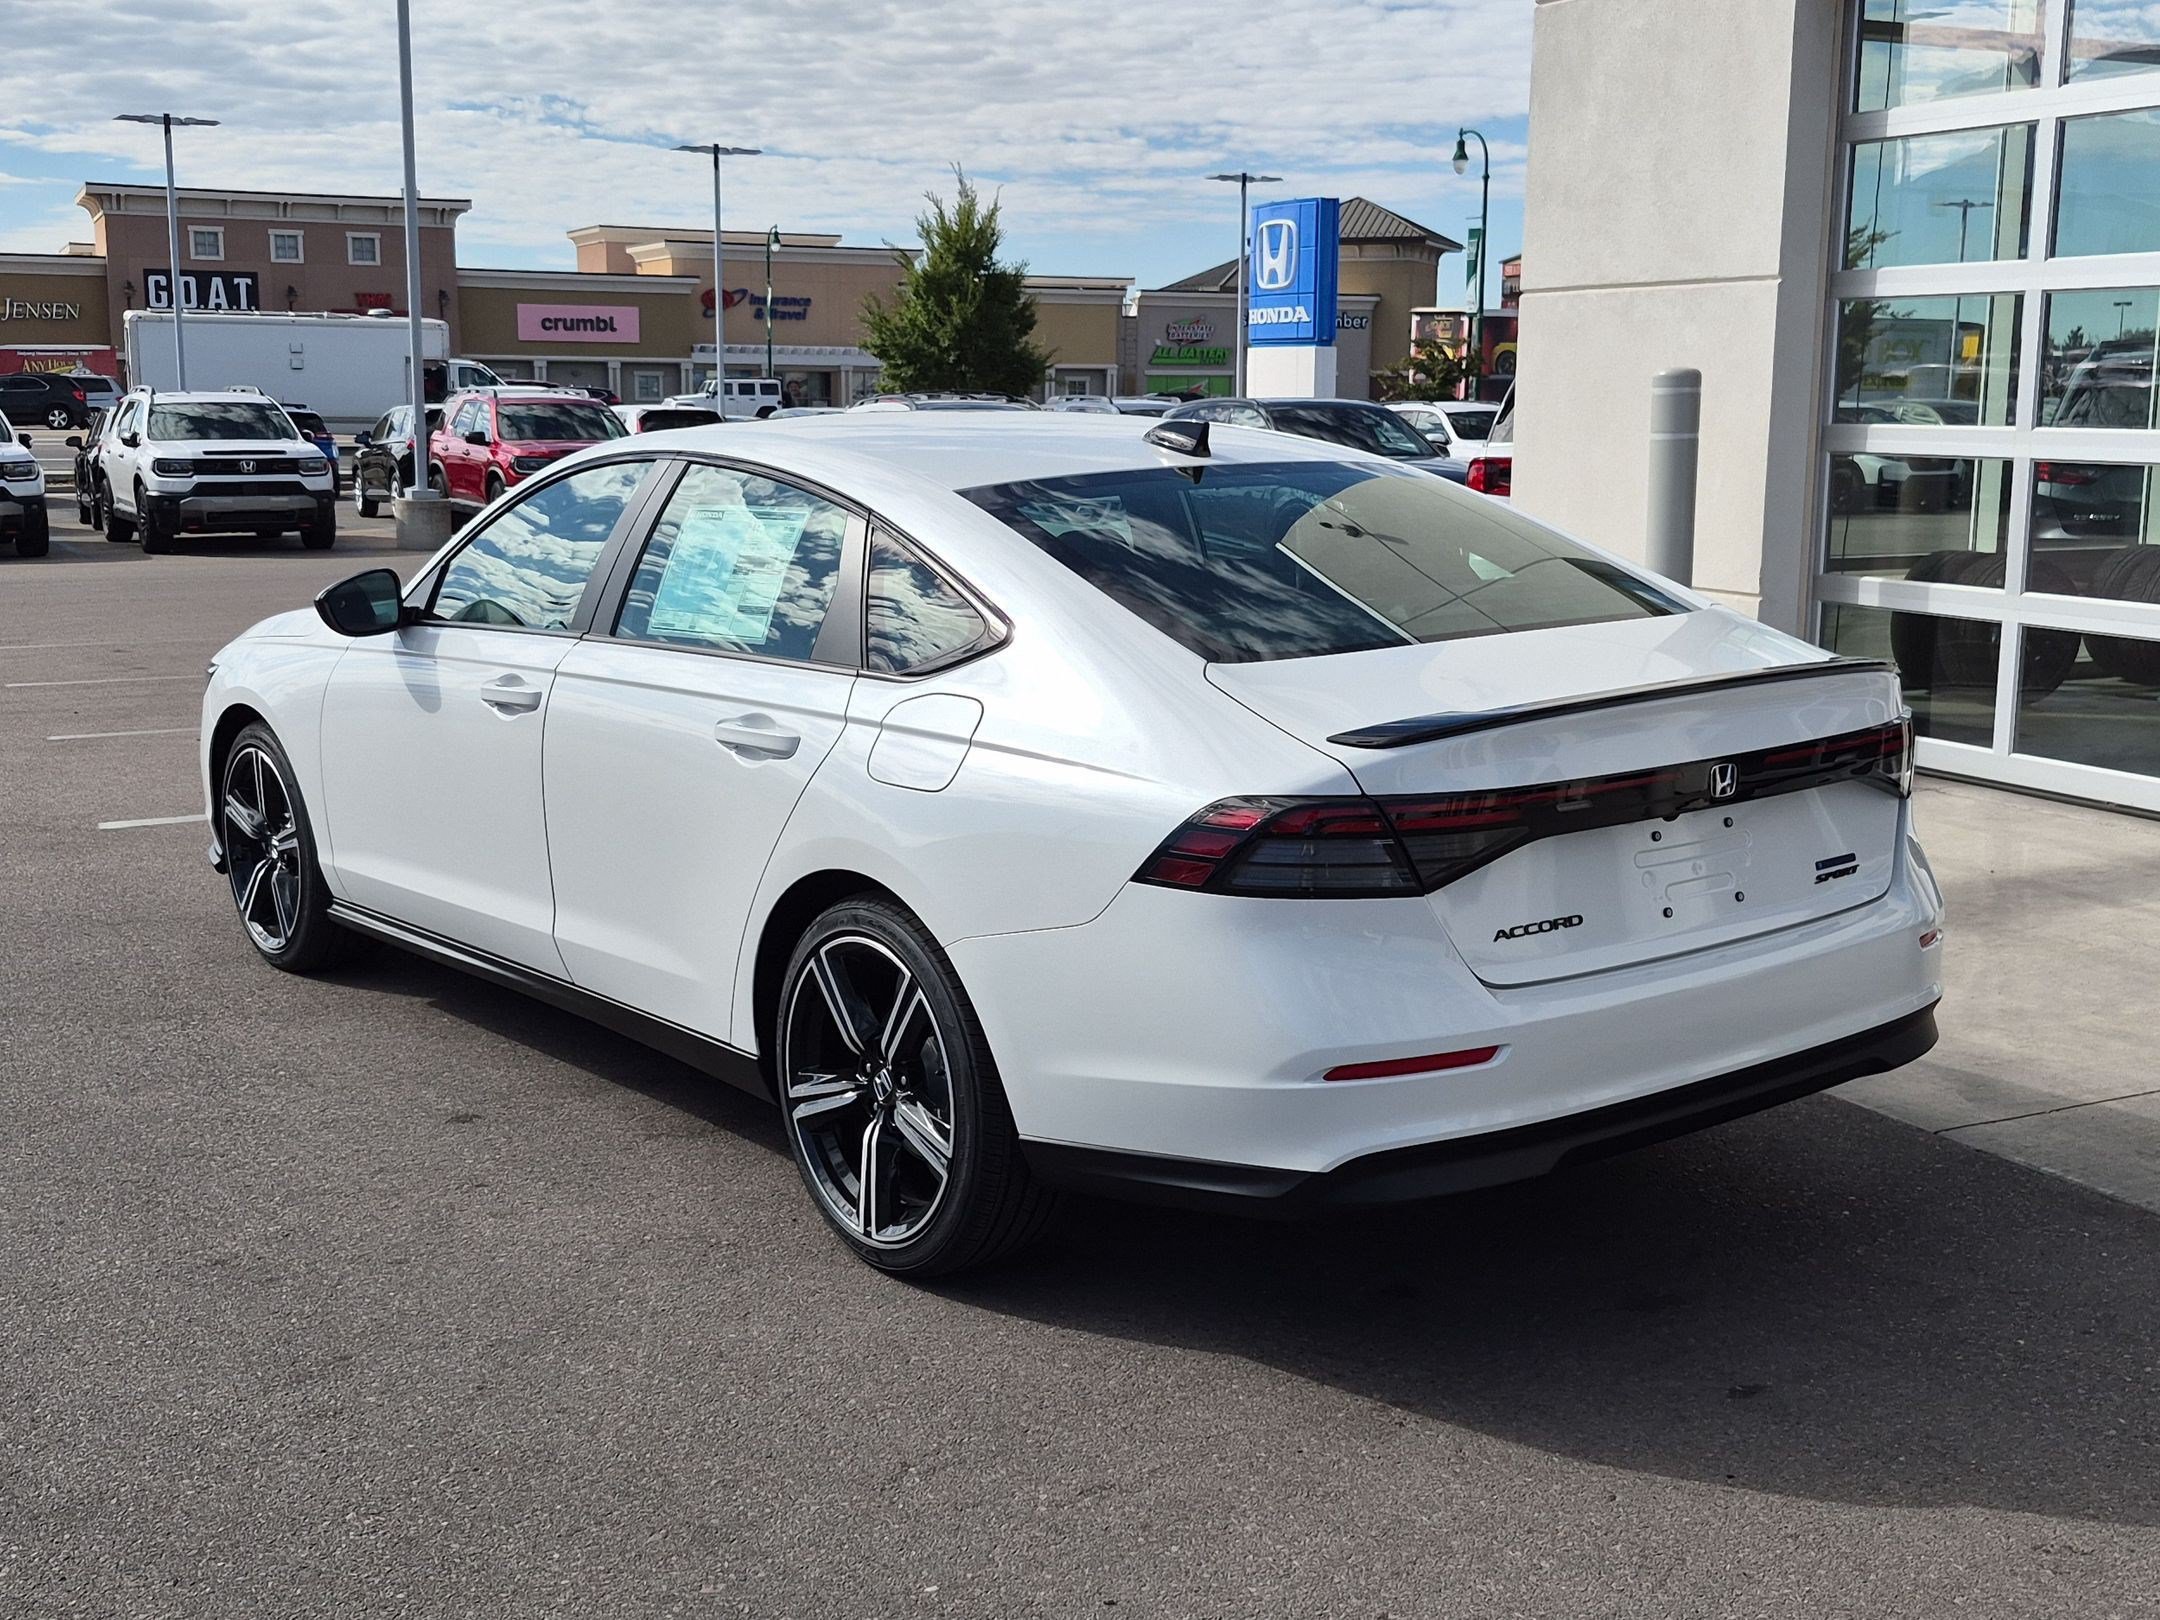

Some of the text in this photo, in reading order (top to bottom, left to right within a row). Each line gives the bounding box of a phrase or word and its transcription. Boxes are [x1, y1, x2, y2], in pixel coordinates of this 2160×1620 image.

[1, 298, 80, 321] JENSEN
[1247, 306, 1312, 325] HONDA
[540, 315, 618, 333] crumbl
[1178, 346, 1232, 359] BATTERY
[1814, 863, 1860, 885] SPORT
[1493, 914, 1584, 942] ACCORD
